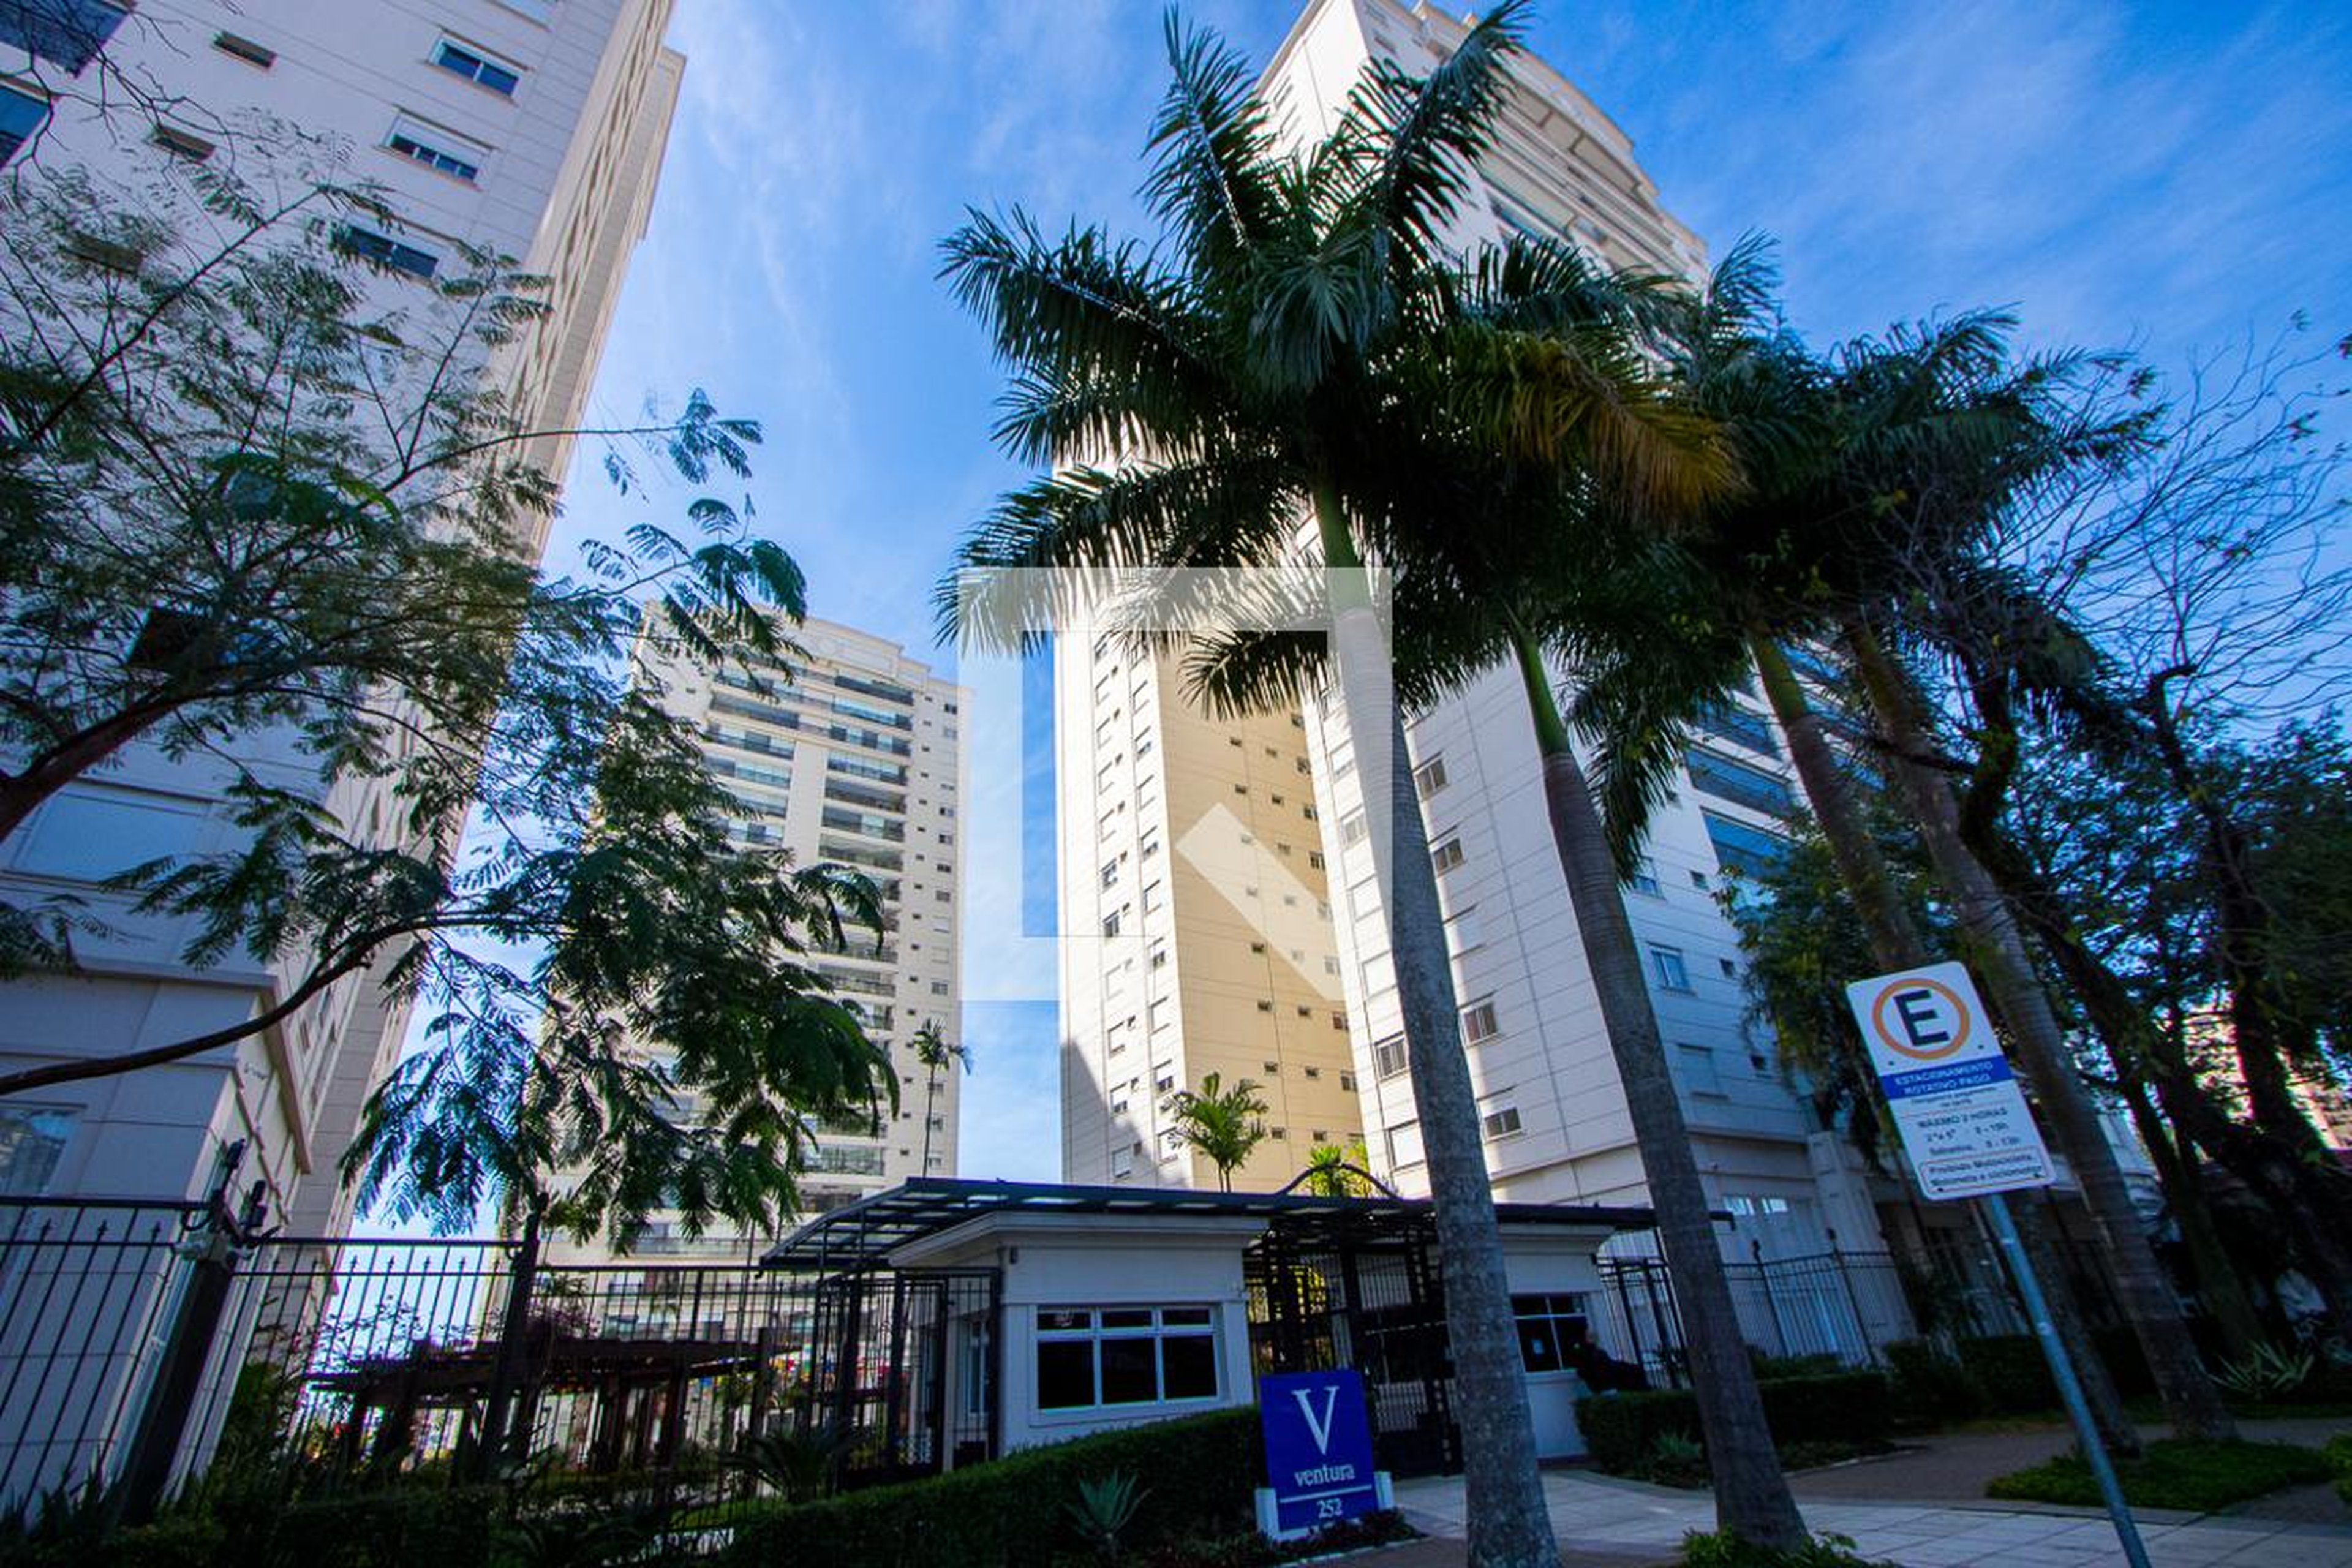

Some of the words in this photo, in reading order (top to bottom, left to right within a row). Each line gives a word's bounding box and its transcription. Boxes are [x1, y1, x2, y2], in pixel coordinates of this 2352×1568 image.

[1894, 989, 1950, 1046] E
[1291, 1386, 1340, 1455] V
[1294, 1464, 1355, 1487] ventura
[1317, 1498, 1343, 1519] 252
